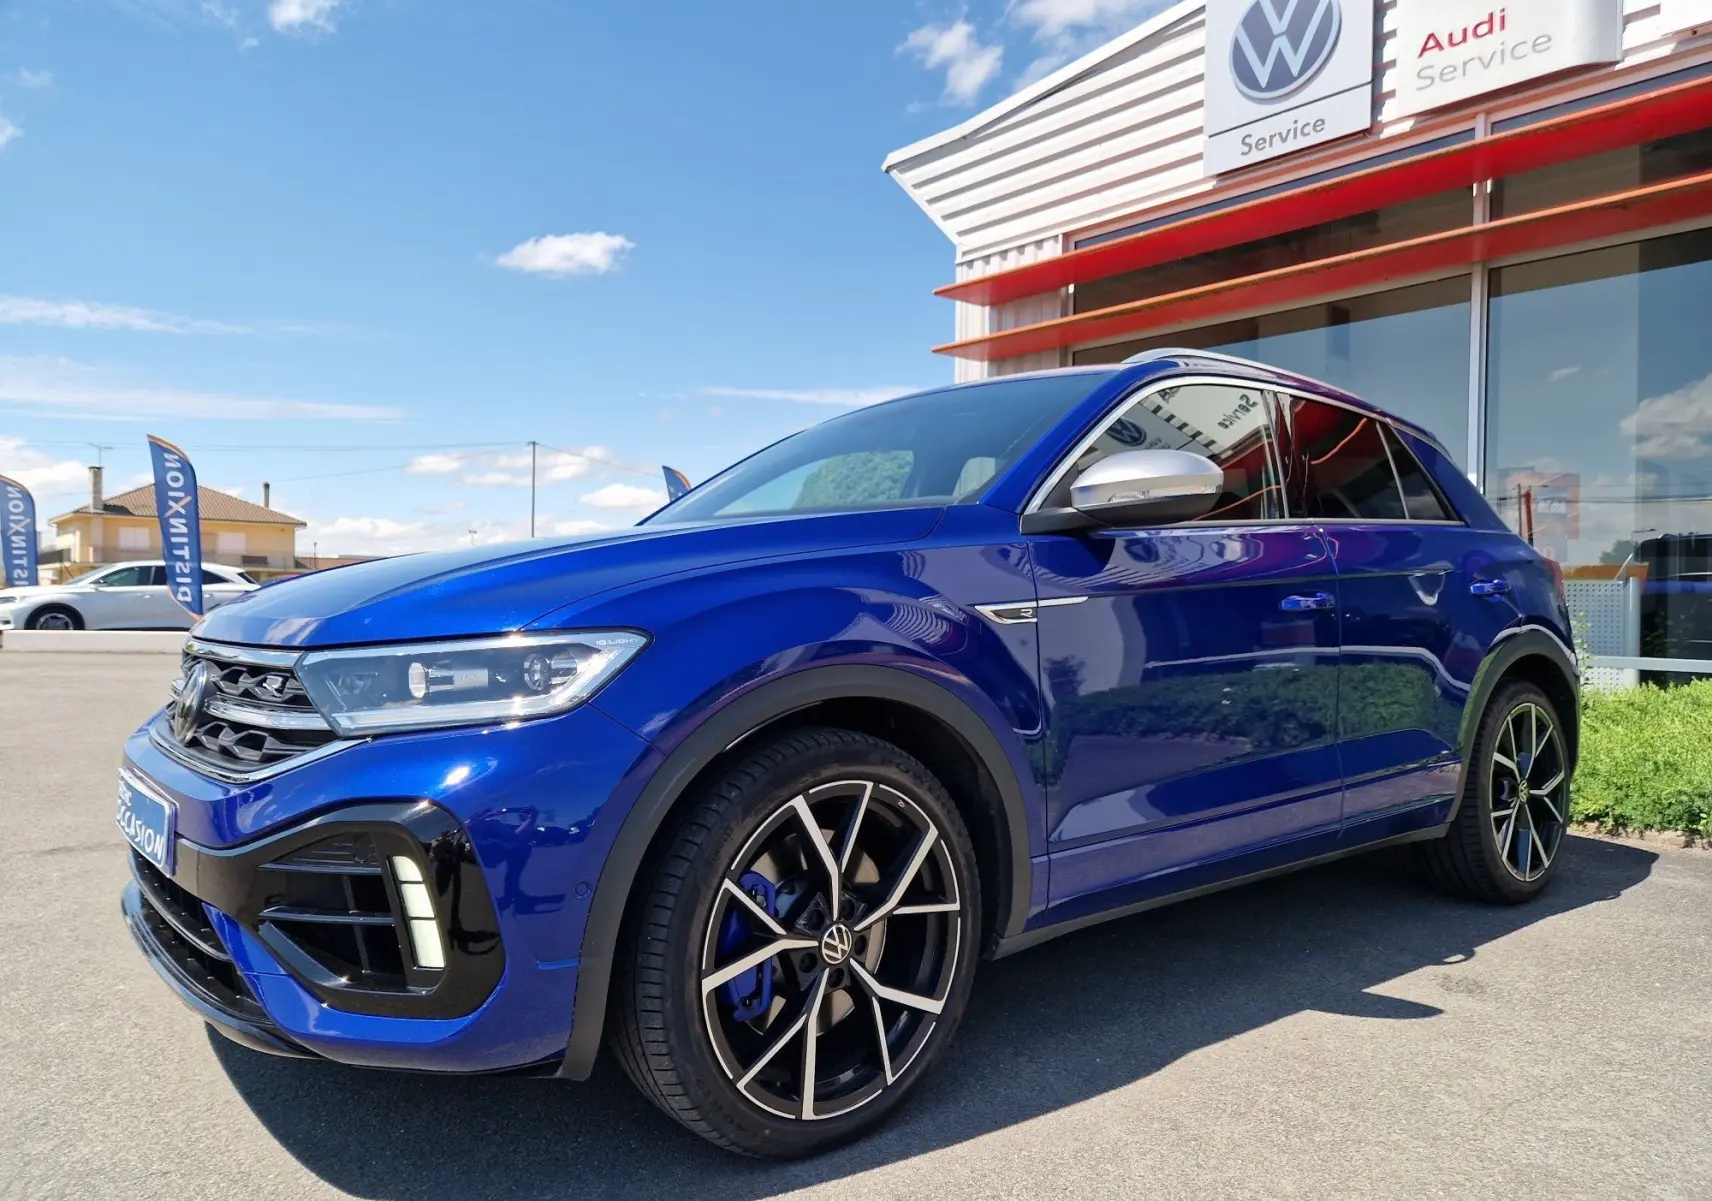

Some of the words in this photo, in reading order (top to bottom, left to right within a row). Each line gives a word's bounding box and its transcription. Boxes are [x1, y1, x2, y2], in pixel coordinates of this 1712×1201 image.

[1232, 0, 1339, 91] VW
[1414, 31, 1553, 91] Service
[1416, 8, 1507, 59] Audi
[1240, 114, 1327, 157] Service
